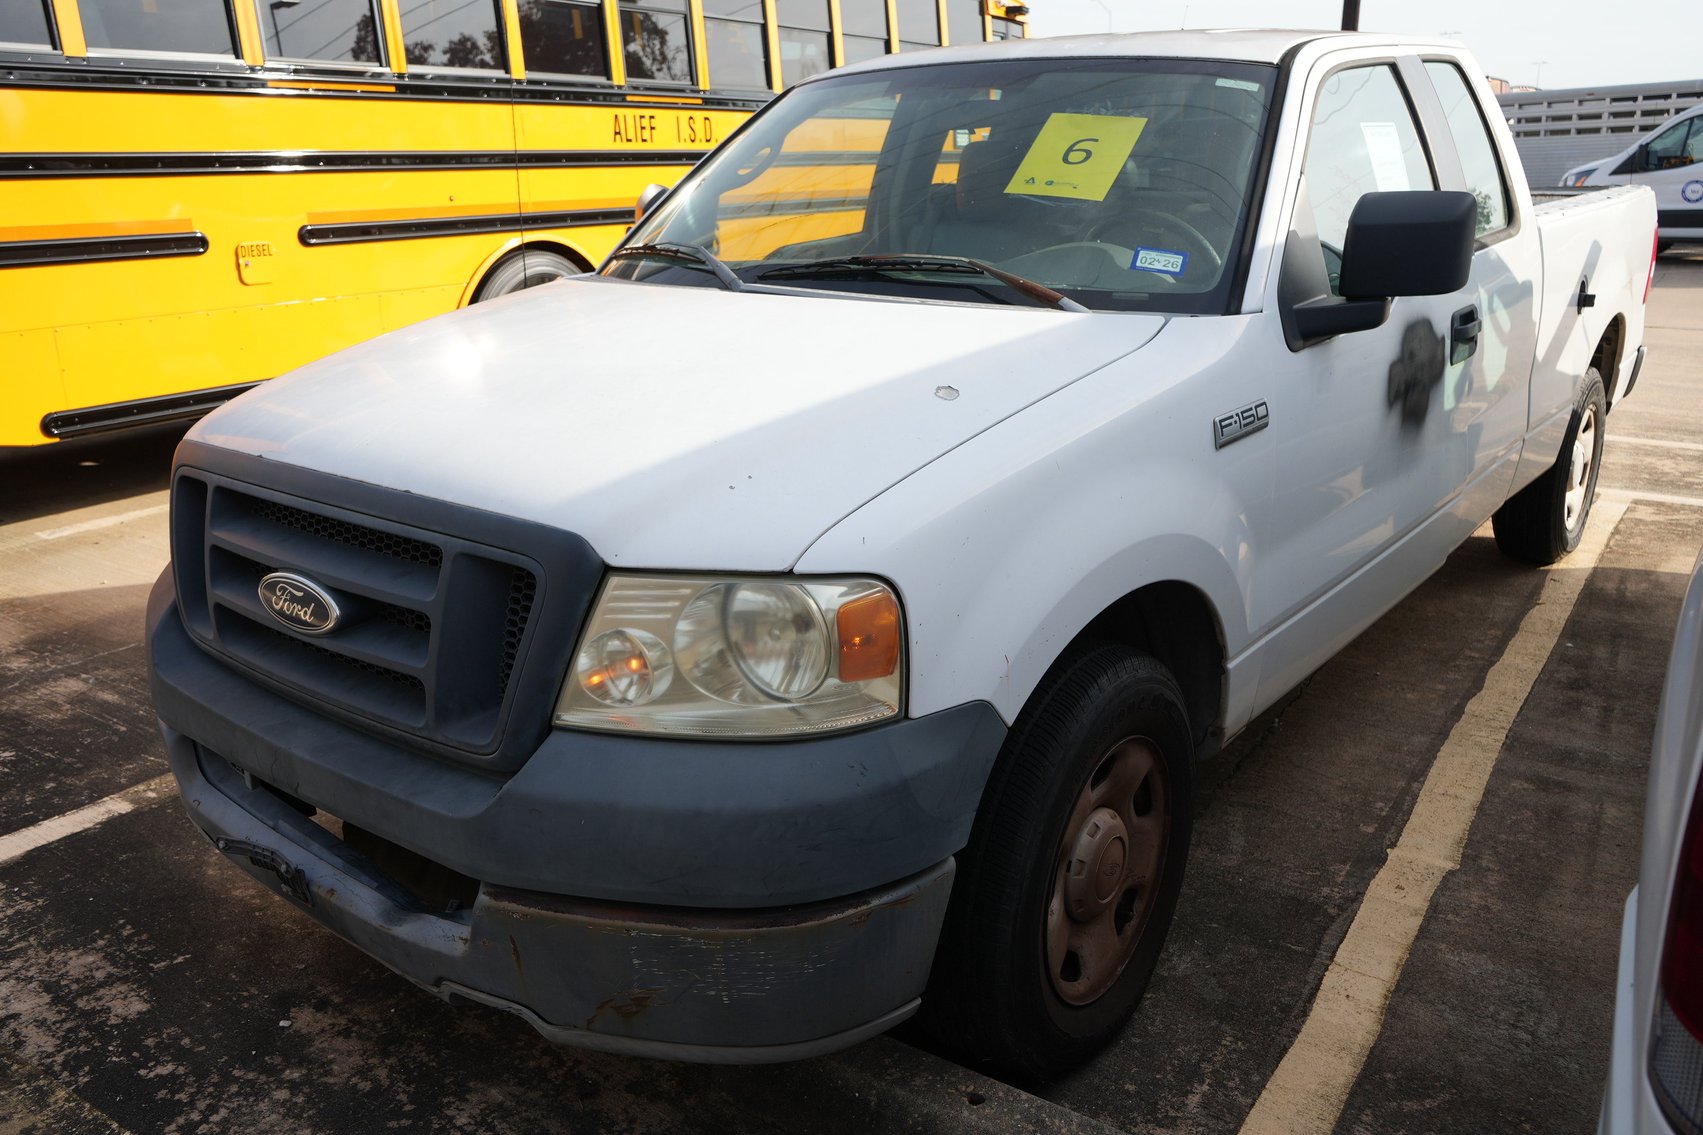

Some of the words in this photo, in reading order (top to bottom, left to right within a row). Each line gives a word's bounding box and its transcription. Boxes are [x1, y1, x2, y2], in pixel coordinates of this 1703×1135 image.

[613, 114, 656, 143] ALIEF
[676, 115, 718, 143] I.S.D.
[1061, 137, 1100, 166] 6
[240, 243, 273, 258] DIESEL
[272, 583, 315, 622] Ford
